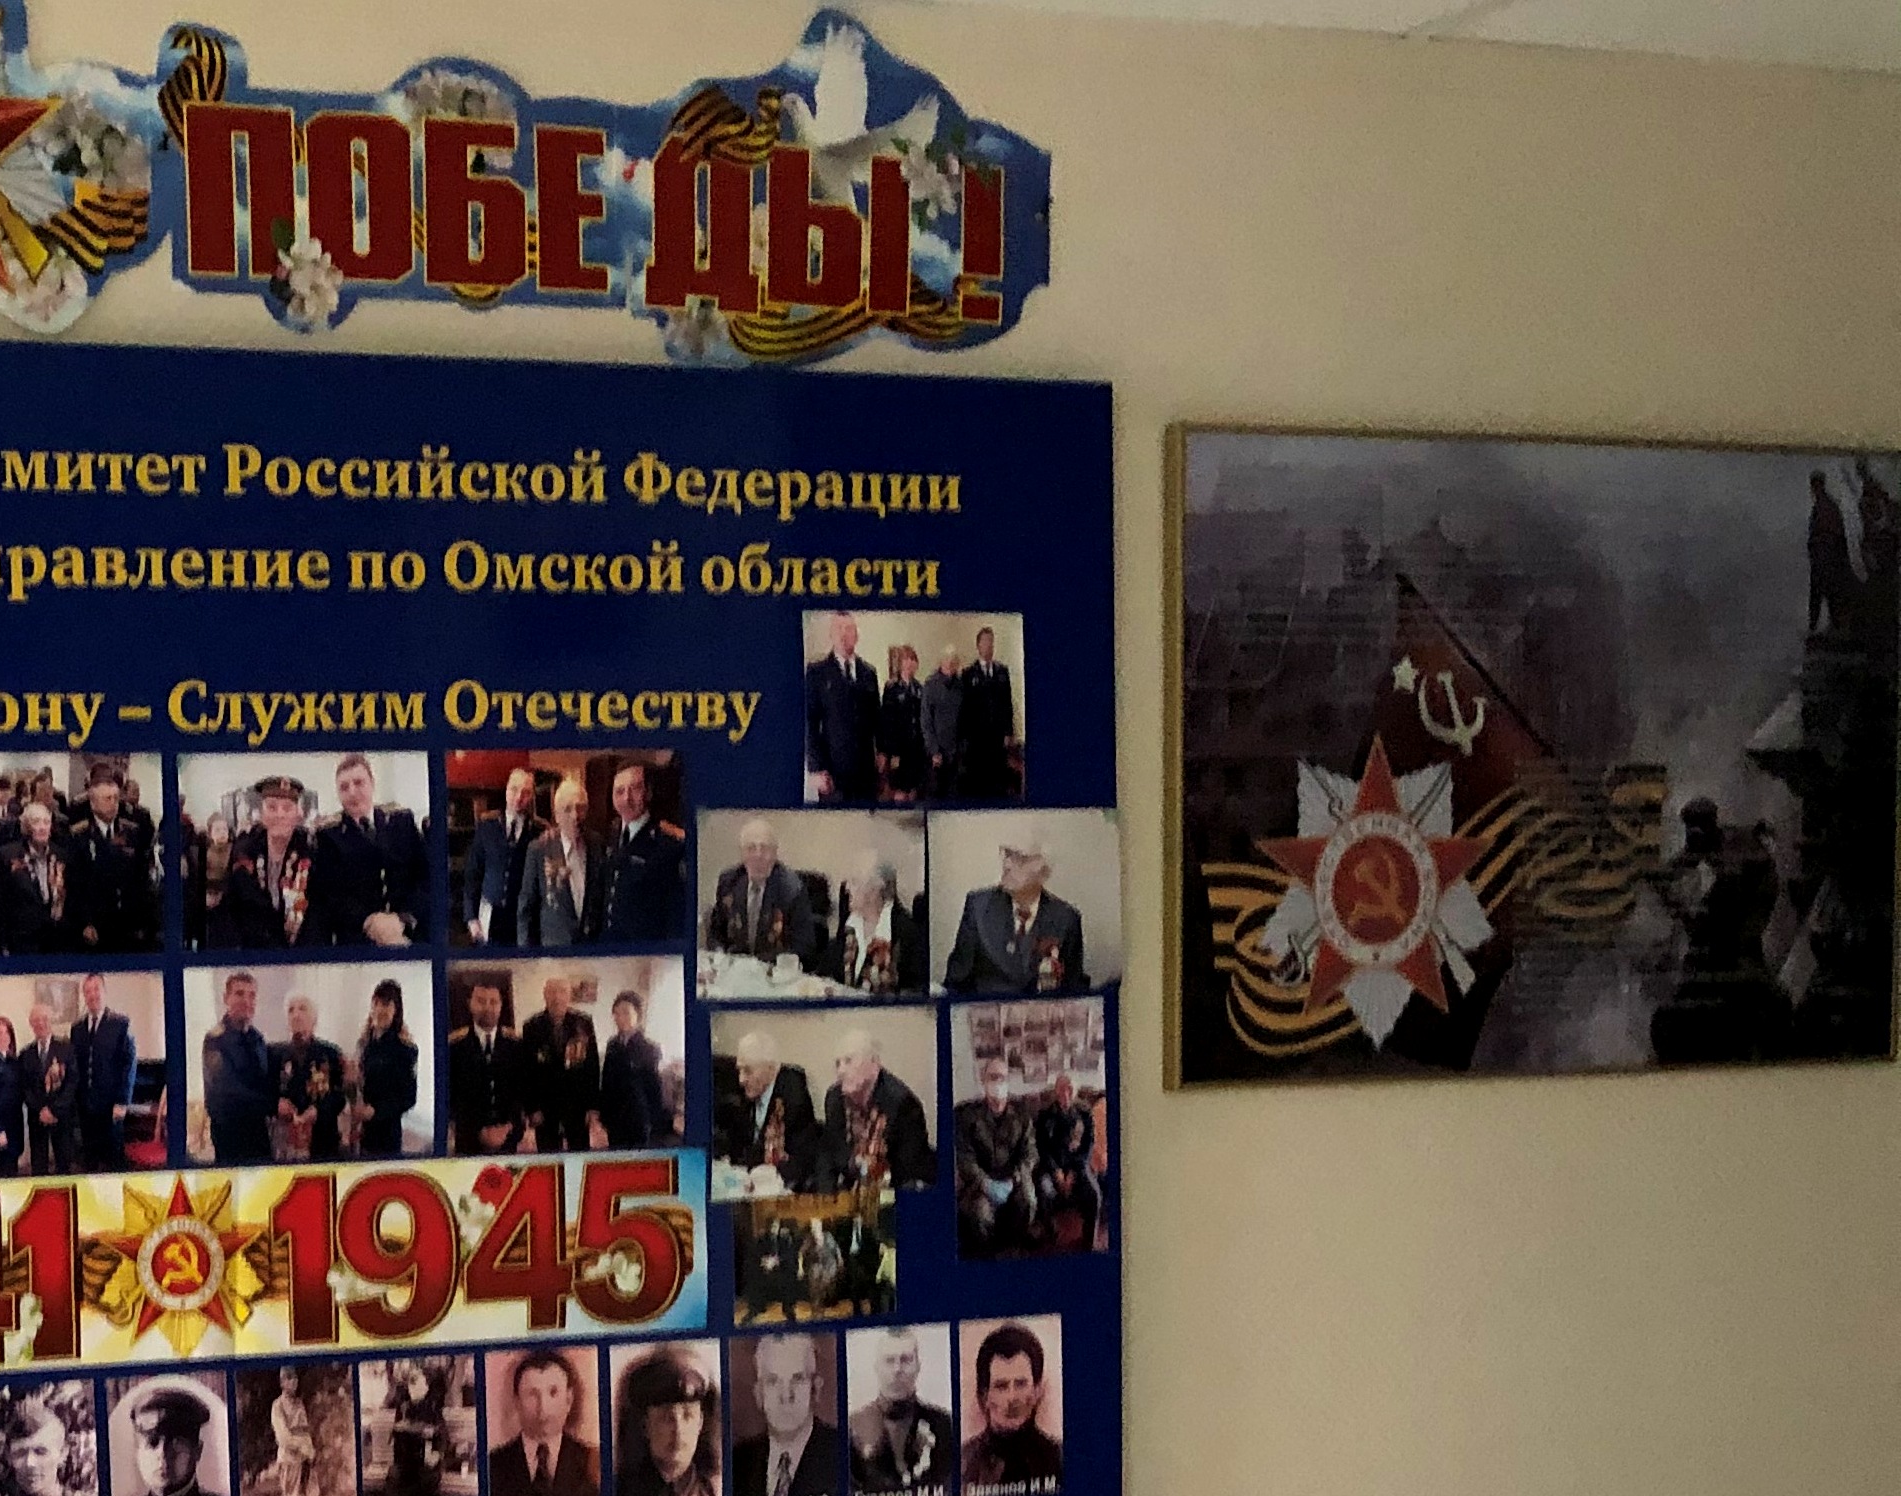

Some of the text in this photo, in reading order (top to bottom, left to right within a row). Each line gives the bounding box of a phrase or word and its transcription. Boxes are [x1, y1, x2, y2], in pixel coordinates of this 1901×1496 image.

[223, 444, 607, 505] Российской
[624, 451, 962, 522] Федерации
[348, 551, 425, 593] по
[444, 539, 683, 595] Омской
[701, 542, 941, 598] области
[167, 677, 425, 747] Служим
[443, 678, 761, 743] Отечеству
[268, 1155, 692, 1347] 1945
